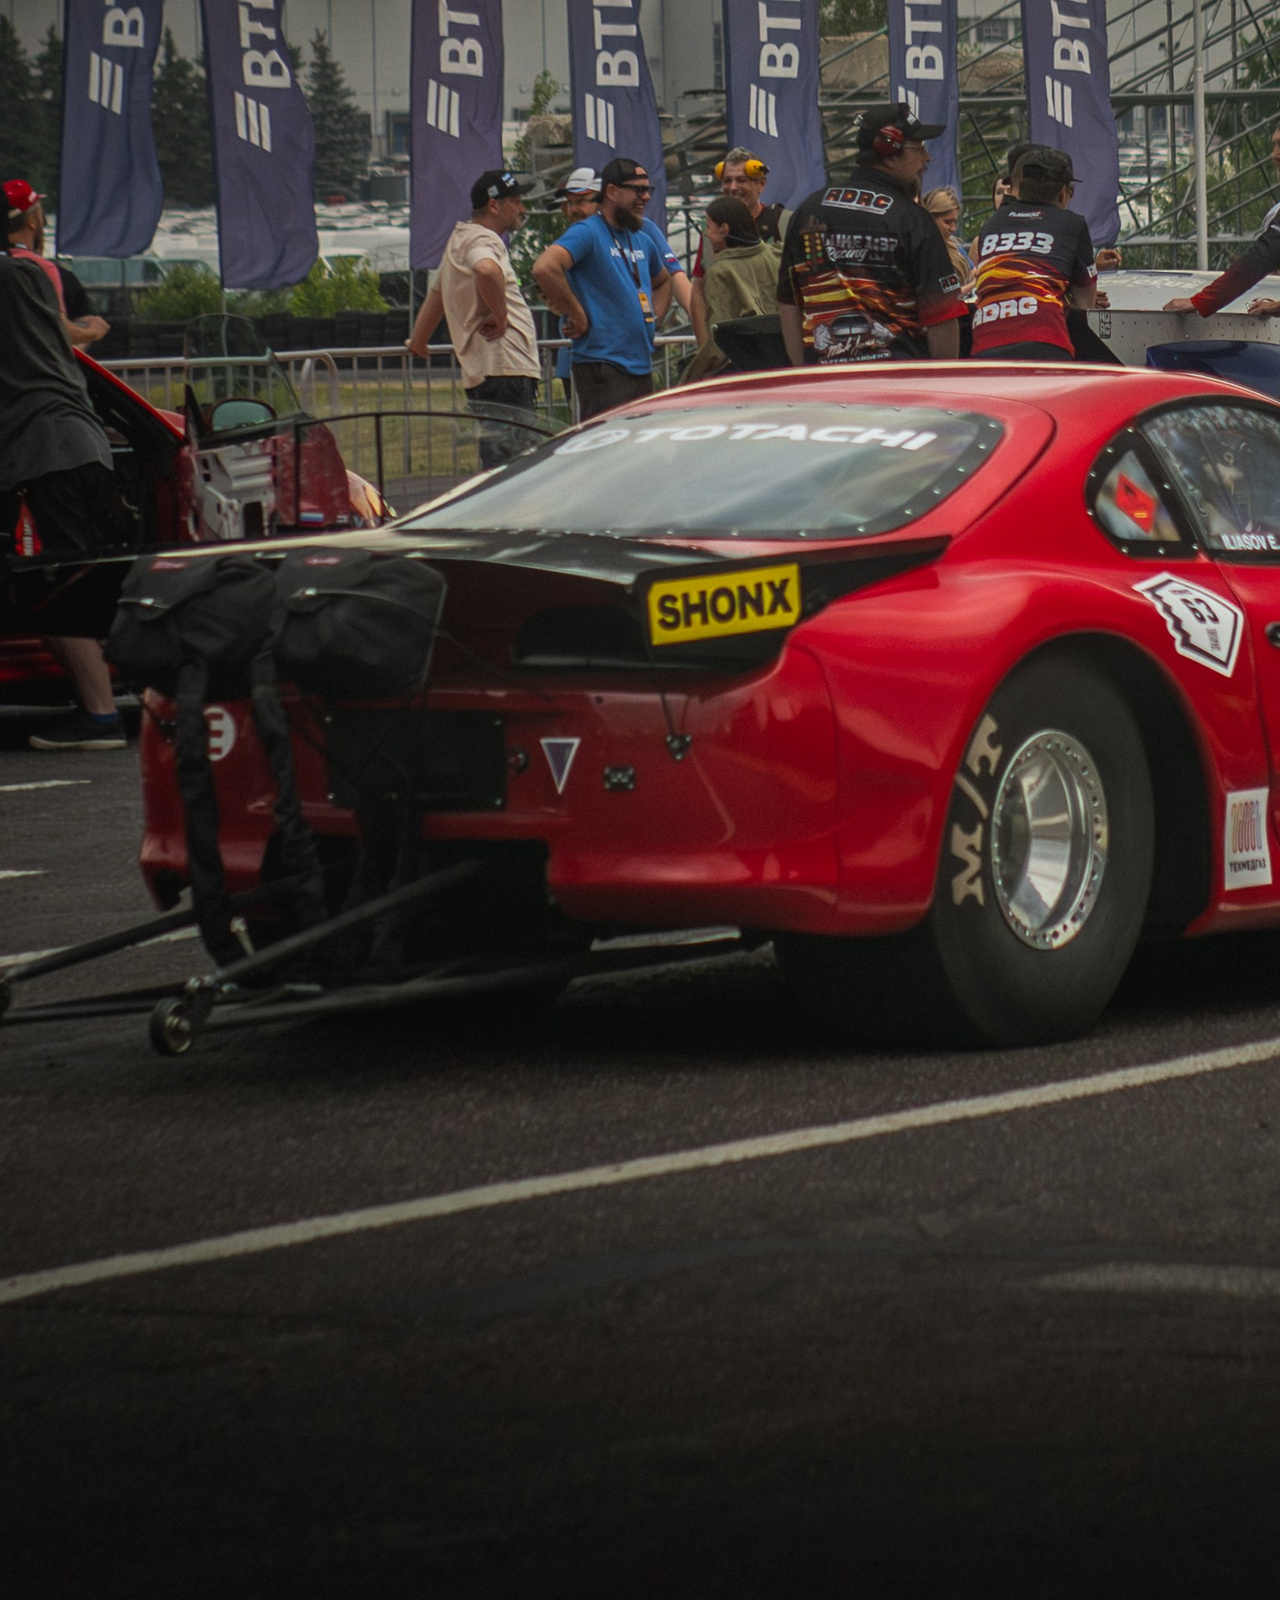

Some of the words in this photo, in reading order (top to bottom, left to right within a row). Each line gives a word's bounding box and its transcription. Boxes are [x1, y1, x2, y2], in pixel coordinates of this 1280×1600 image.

[981, 232, 1054, 257] 8333
[634, 423, 938, 451] TOTACHI
[1221, 533, 1268, 550] ILIASOV
[657, 578, 793, 632] SHONX
